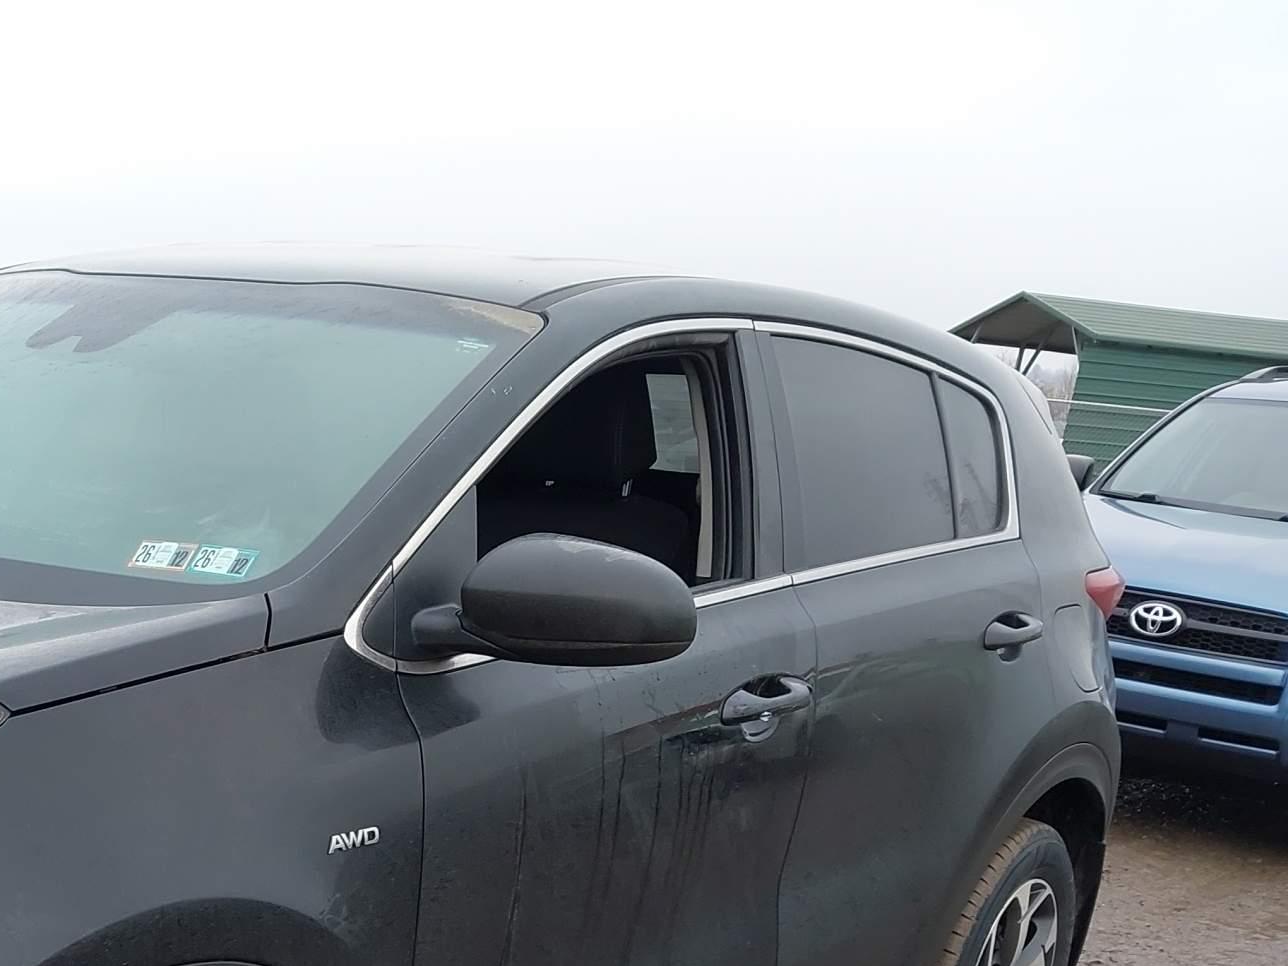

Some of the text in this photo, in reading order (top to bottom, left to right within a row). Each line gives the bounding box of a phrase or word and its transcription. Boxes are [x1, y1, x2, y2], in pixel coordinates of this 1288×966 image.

[135, 544, 156, 563] 26
[170, 550, 189, 567] 12
[194, 549, 216, 568] 26
[229, 557, 249, 575] 12
[328, 826, 380, 855] AWD
